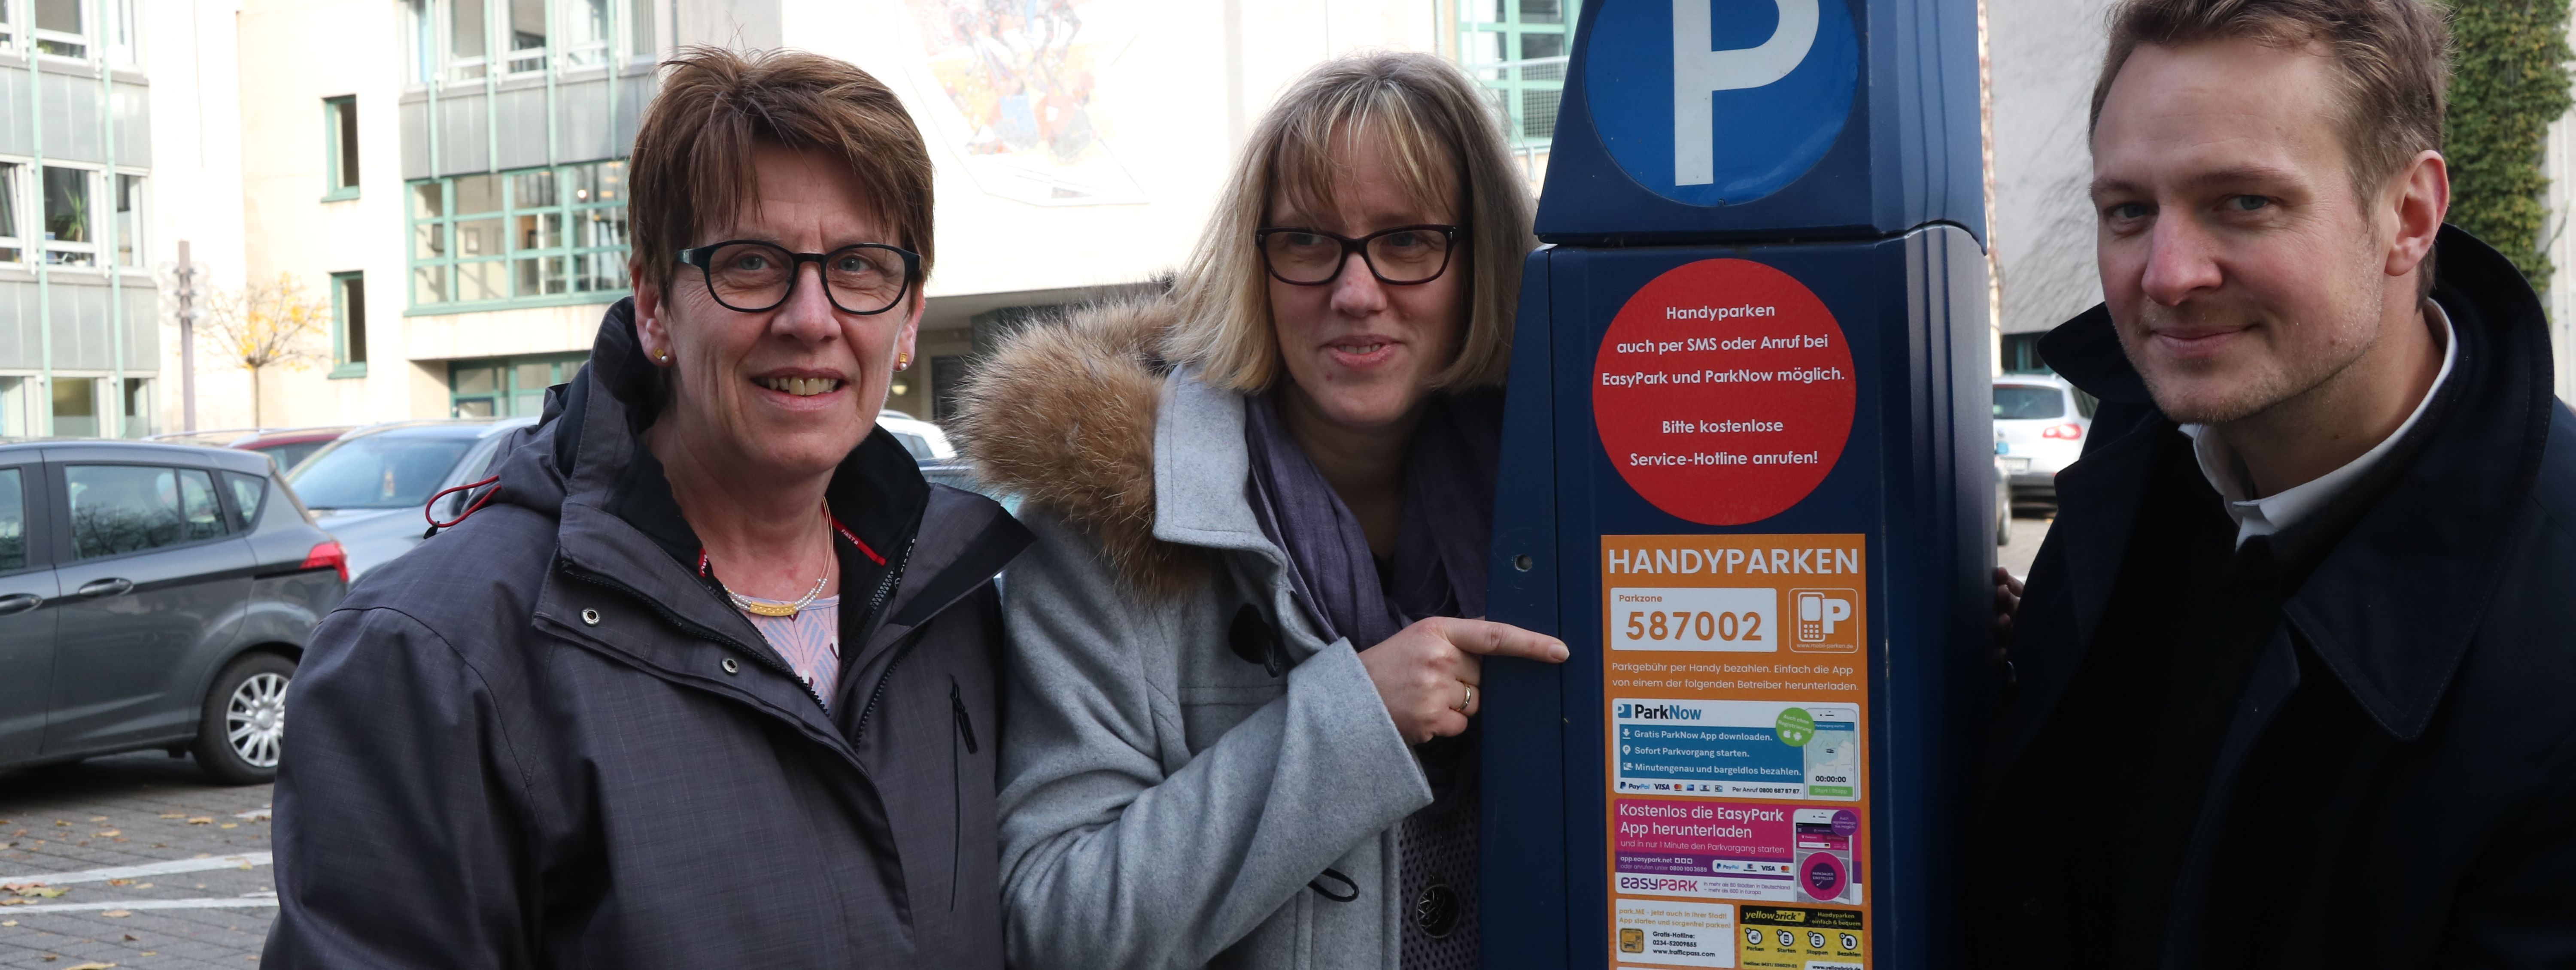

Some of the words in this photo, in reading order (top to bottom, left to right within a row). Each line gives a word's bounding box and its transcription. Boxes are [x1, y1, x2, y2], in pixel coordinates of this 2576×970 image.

[1673, 0, 1820, 186] P
[1667, 304, 1774, 321] Handyparken
[1617, 340, 1654, 353] auch
[1659, 342, 1683, 355] per
[1687, 338, 1716, 351] SMS
[1721, 337, 1756, 350] oder
[1761, 335, 1800, 349] Anruf
[1804, 334, 1828, 348] bei
[1603, 371, 1668, 388] EasyPark
[1673, 370, 1700, 383] und
[1706, 368, 1773, 382] ParkNow
[1778, 367, 1844, 383] möglich.
[1663, 421, 1695, 433] Bitte
[1700, 419, 1783, 432] kostenlose
[1631, 452, 1747, 466] Service-Hotline
[1753, 451, 1817, 464] anrufen!
[841, 529, 855, 541] FIRST
[1609, 549, 1857, 573] HANDYPARKEN
[1823, 599, 1851, 634] P
[1626, 611, 1762, 641] 587002
[1613, 663, 1667, 673] Parkgebühr
[1671, 665, 1686, 674] per
[1689, 664, 1721, 674] Handy
[1724, 664, 1771, 673] bezahlen.
[1774, 664, 1810, 674] Einfach
[1814, 665, 1829, 674] die
[1832, 665, 1853, 676] App
[1633, 678, 1663, 687] einem
[1666, 678, 1682, 688] der
[1685, 679, 1734, 690] folgenden
[1737, 679, 1782, 690] Betreiber
[1785, 680, 1859, 691] herunterladen.
[1635, 704, 1701, 719] ParkNow
[1778, 720, 1812, 733] Registrierung
[1700, 732, 1716, 741] App
[1662, 748, 1714, 758] Parkvorgang
[1635, 763, 1694, 773] Minutengenau
[1714, 766, 1758, 775] bargeldlos
[1760, 767, 1801, 776] bezahlen.
[1621, 804, 1686, 818] Kostenlos
[1692, 806, 1713, 818] die
[1718, 807, 1783, 824] EasyPark
[1621, 822, 1648, 837] App
[1653, 822, 1751, 838] herunterladen
[1707, 844, 1755, 854] Parkvorgang
[1745, 911, 1796, 921] yellowbrick
[1653, 949, 1715, 957] www.trafficpass.com
